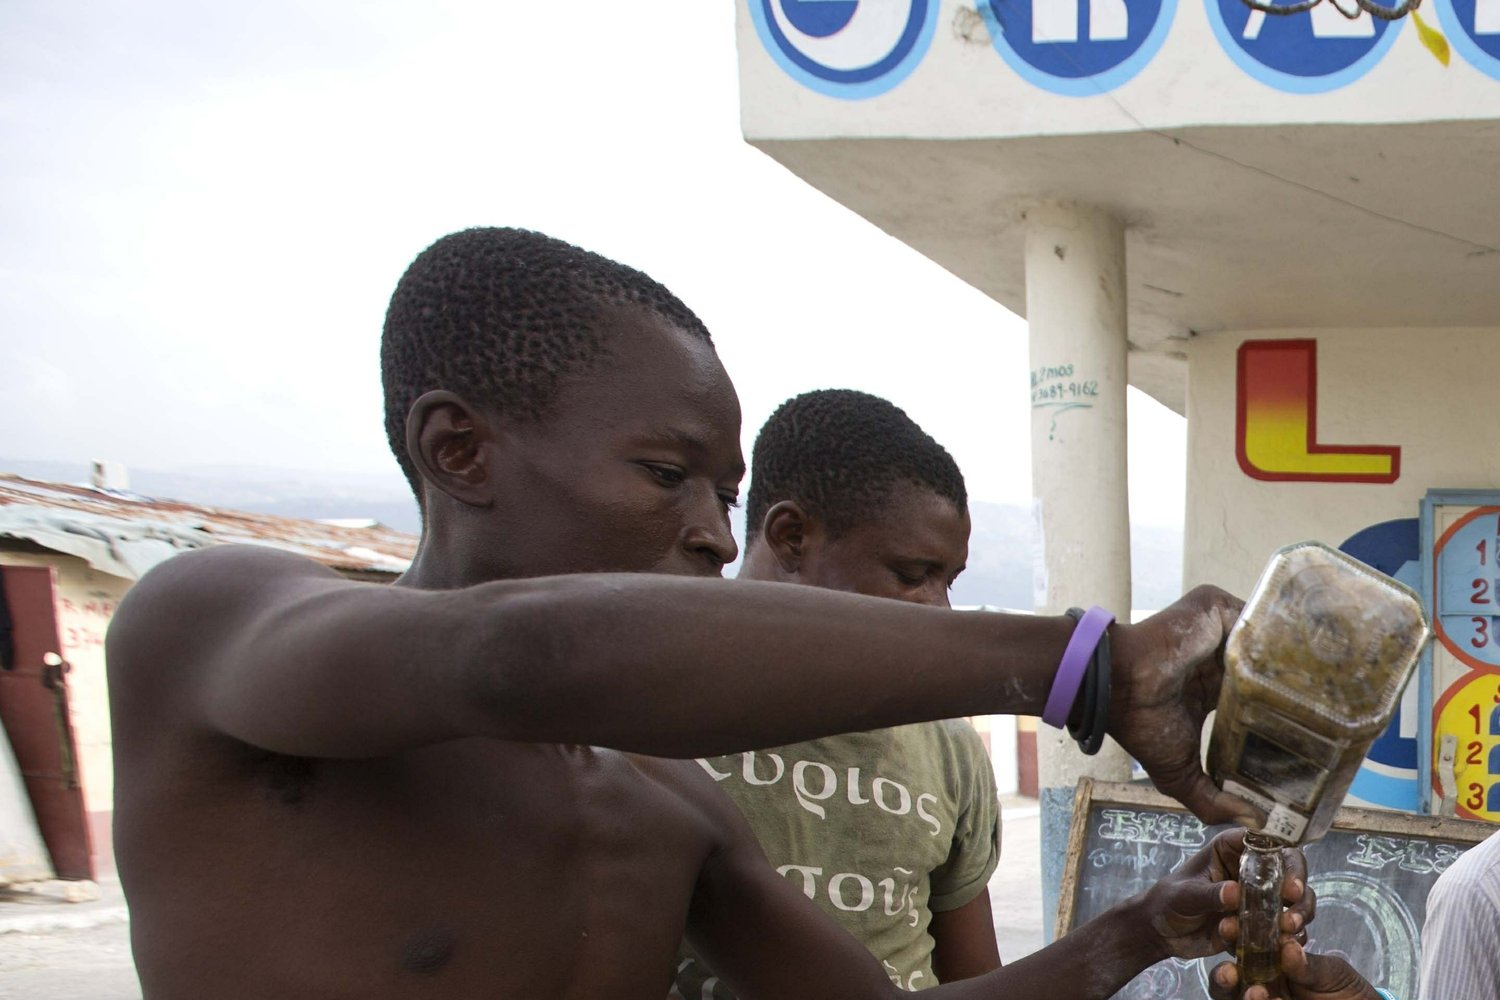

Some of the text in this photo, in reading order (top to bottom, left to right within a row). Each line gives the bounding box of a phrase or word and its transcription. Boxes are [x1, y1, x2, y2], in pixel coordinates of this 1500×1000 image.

[1476, 539, 1486, 566] 1
[1470, 578, 1490, 604] 2
[1471, 616, 1489, 648] 3
[1468, 704, 1480, 735] 1
[1466, 741, 1483, 765] 2
[1466, 783, 1484, 810] 3
